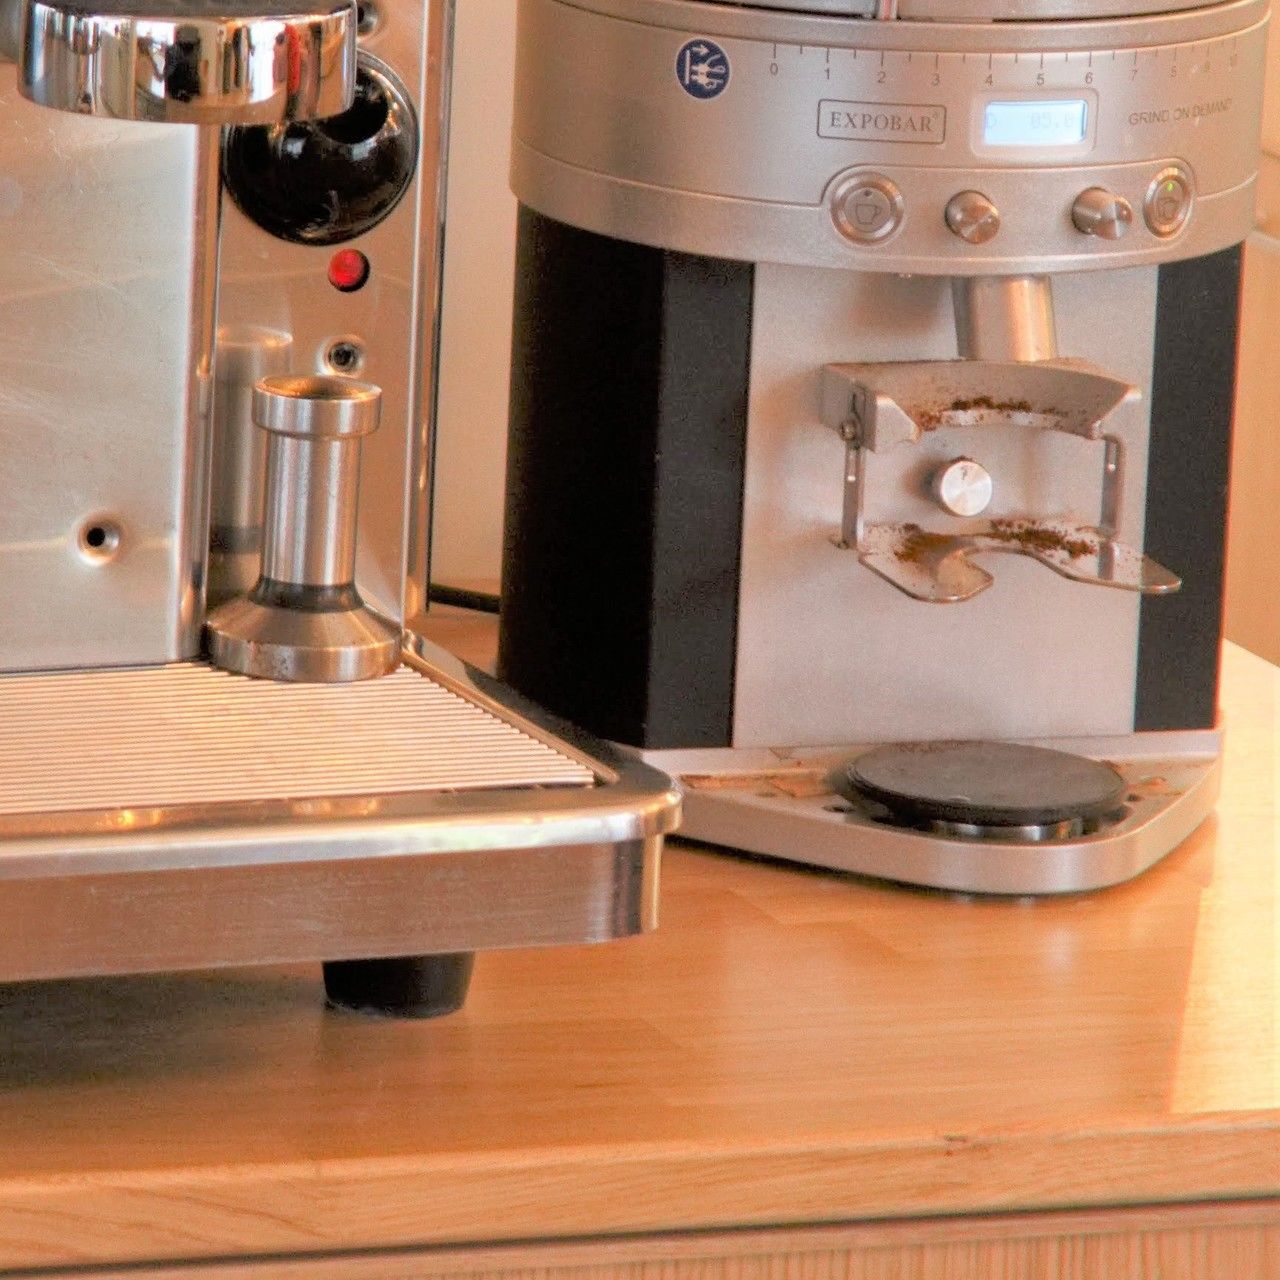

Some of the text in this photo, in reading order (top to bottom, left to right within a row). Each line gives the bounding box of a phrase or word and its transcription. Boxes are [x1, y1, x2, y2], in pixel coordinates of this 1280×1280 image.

[769, 62, 779, 76] 0
[877, 71, 887, 84] 2
[931, 73, 941, 86] 3
[985, 73, 994, 87] 4
[1036, 73, 1045, 87] 5
[1085, 71, 1094, 84] 6
[830, 111, 933, 132] EXPOBAR
[1128, 109, 1170, 125] GRIND
